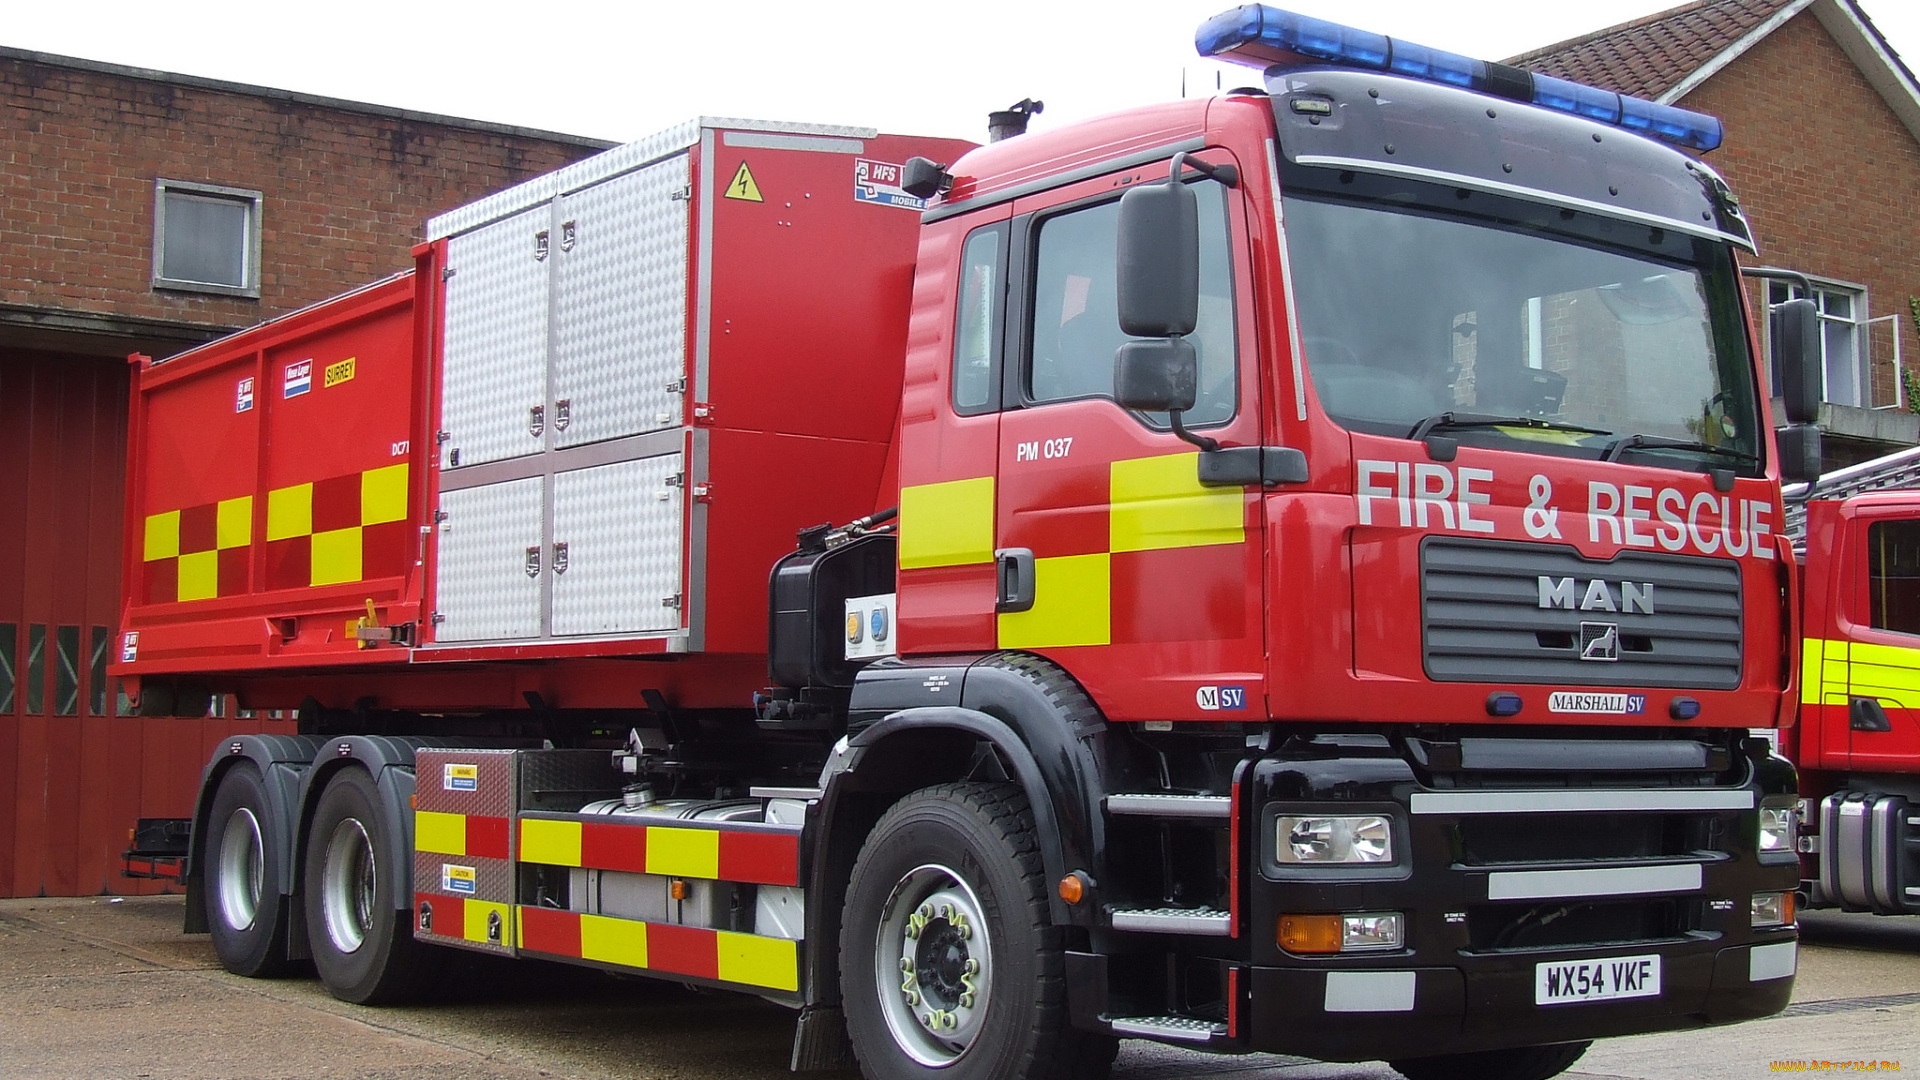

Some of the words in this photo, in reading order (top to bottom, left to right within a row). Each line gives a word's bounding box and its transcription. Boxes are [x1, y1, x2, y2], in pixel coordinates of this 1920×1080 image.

[873, 164, 897, 182] HFS
[890, 195, 922, 207] MOBILE
[326, 361, 354, 384] SURREY
[1017, 441, 1039, 462] PM
[1044, 437, 1073, 459] 037
[1357, 459, 1495, 534] FIRE
[1522, 474, 1562, 540] &
[1588, 480, 1775, 560] RESCUE
[1538, 575, 1655, 616] MAN
[1553, 694, 1625, 712] MARSHALL
[1627, 696, 1645, 712] SV
[1547, 964, 1604, 997] WX54
[1612, 961, 1651, 992] VKF
